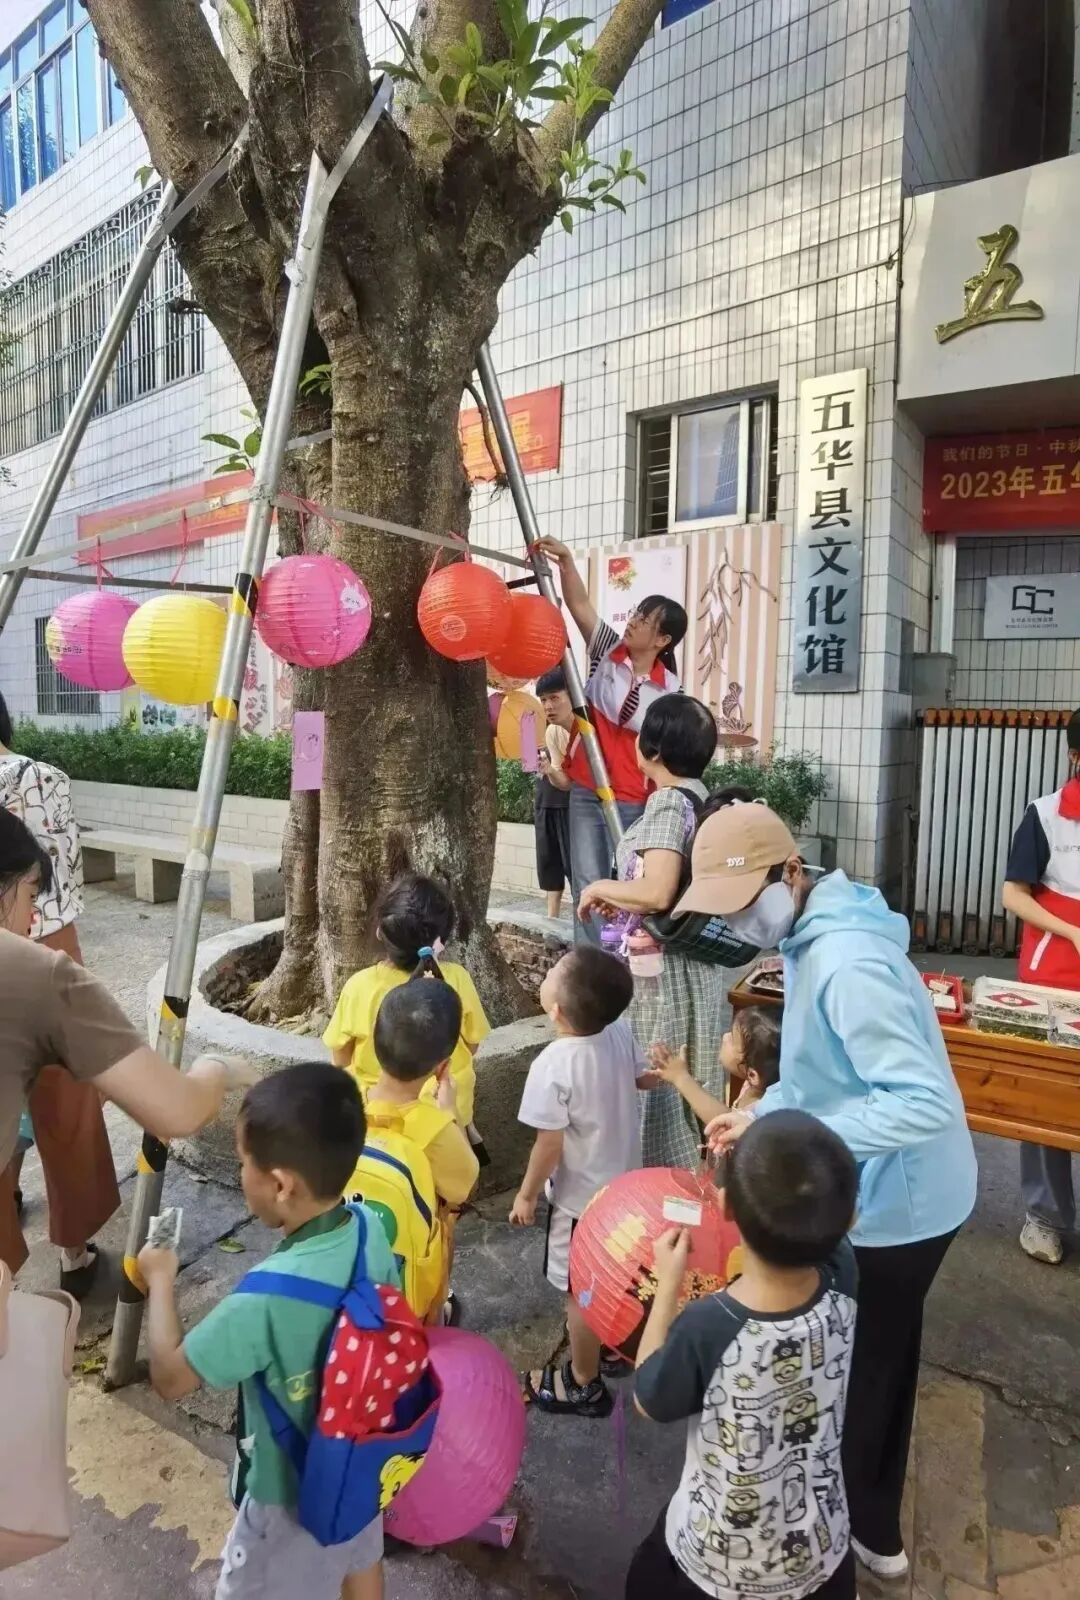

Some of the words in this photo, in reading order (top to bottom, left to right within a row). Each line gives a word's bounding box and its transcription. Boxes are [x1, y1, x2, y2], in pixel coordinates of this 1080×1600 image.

[934, 224, 1045, 344] 五
[801, 389, 855, 674] 五华县文化馆
